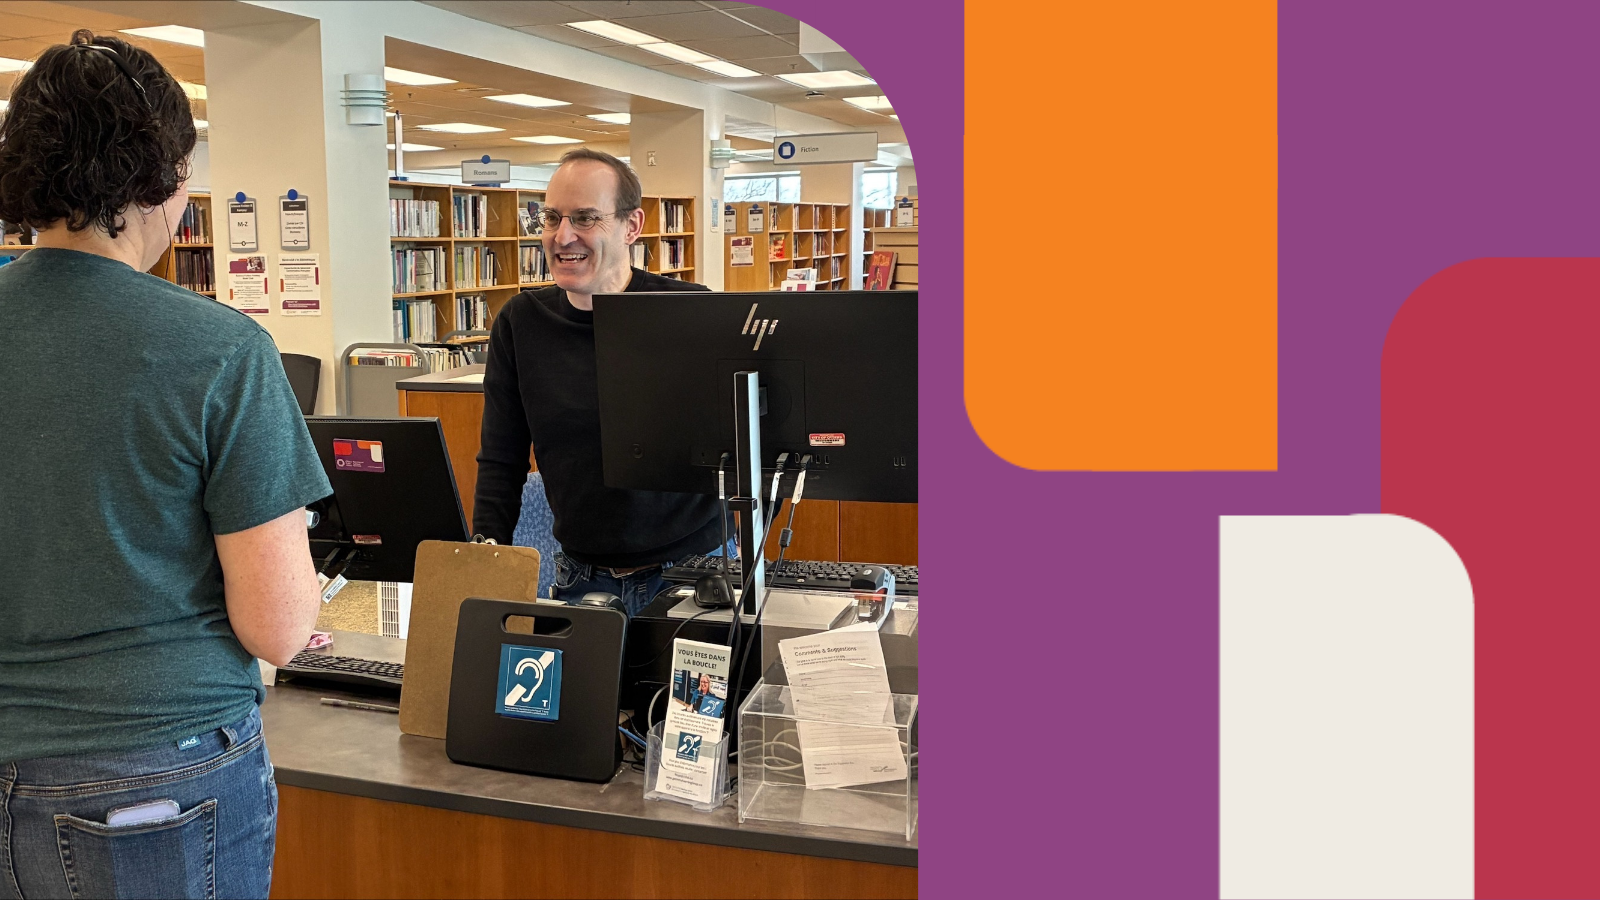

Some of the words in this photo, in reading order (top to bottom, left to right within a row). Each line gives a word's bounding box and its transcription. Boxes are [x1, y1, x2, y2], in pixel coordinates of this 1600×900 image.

[741, 303, 779, 351] hp
[678, 648, 694, 657] VOUS
[694, 650, 708, 659] ÊTES
[708, 653, 726, 662] DANS
[794, 648, 821, 657] Comments
[826, 646, 857, 654] Suggestions
[692, 660, 717, 669] BOUCLE!
[541, 699, 549, 708] T
[180, 738, 198, 747] JAG
